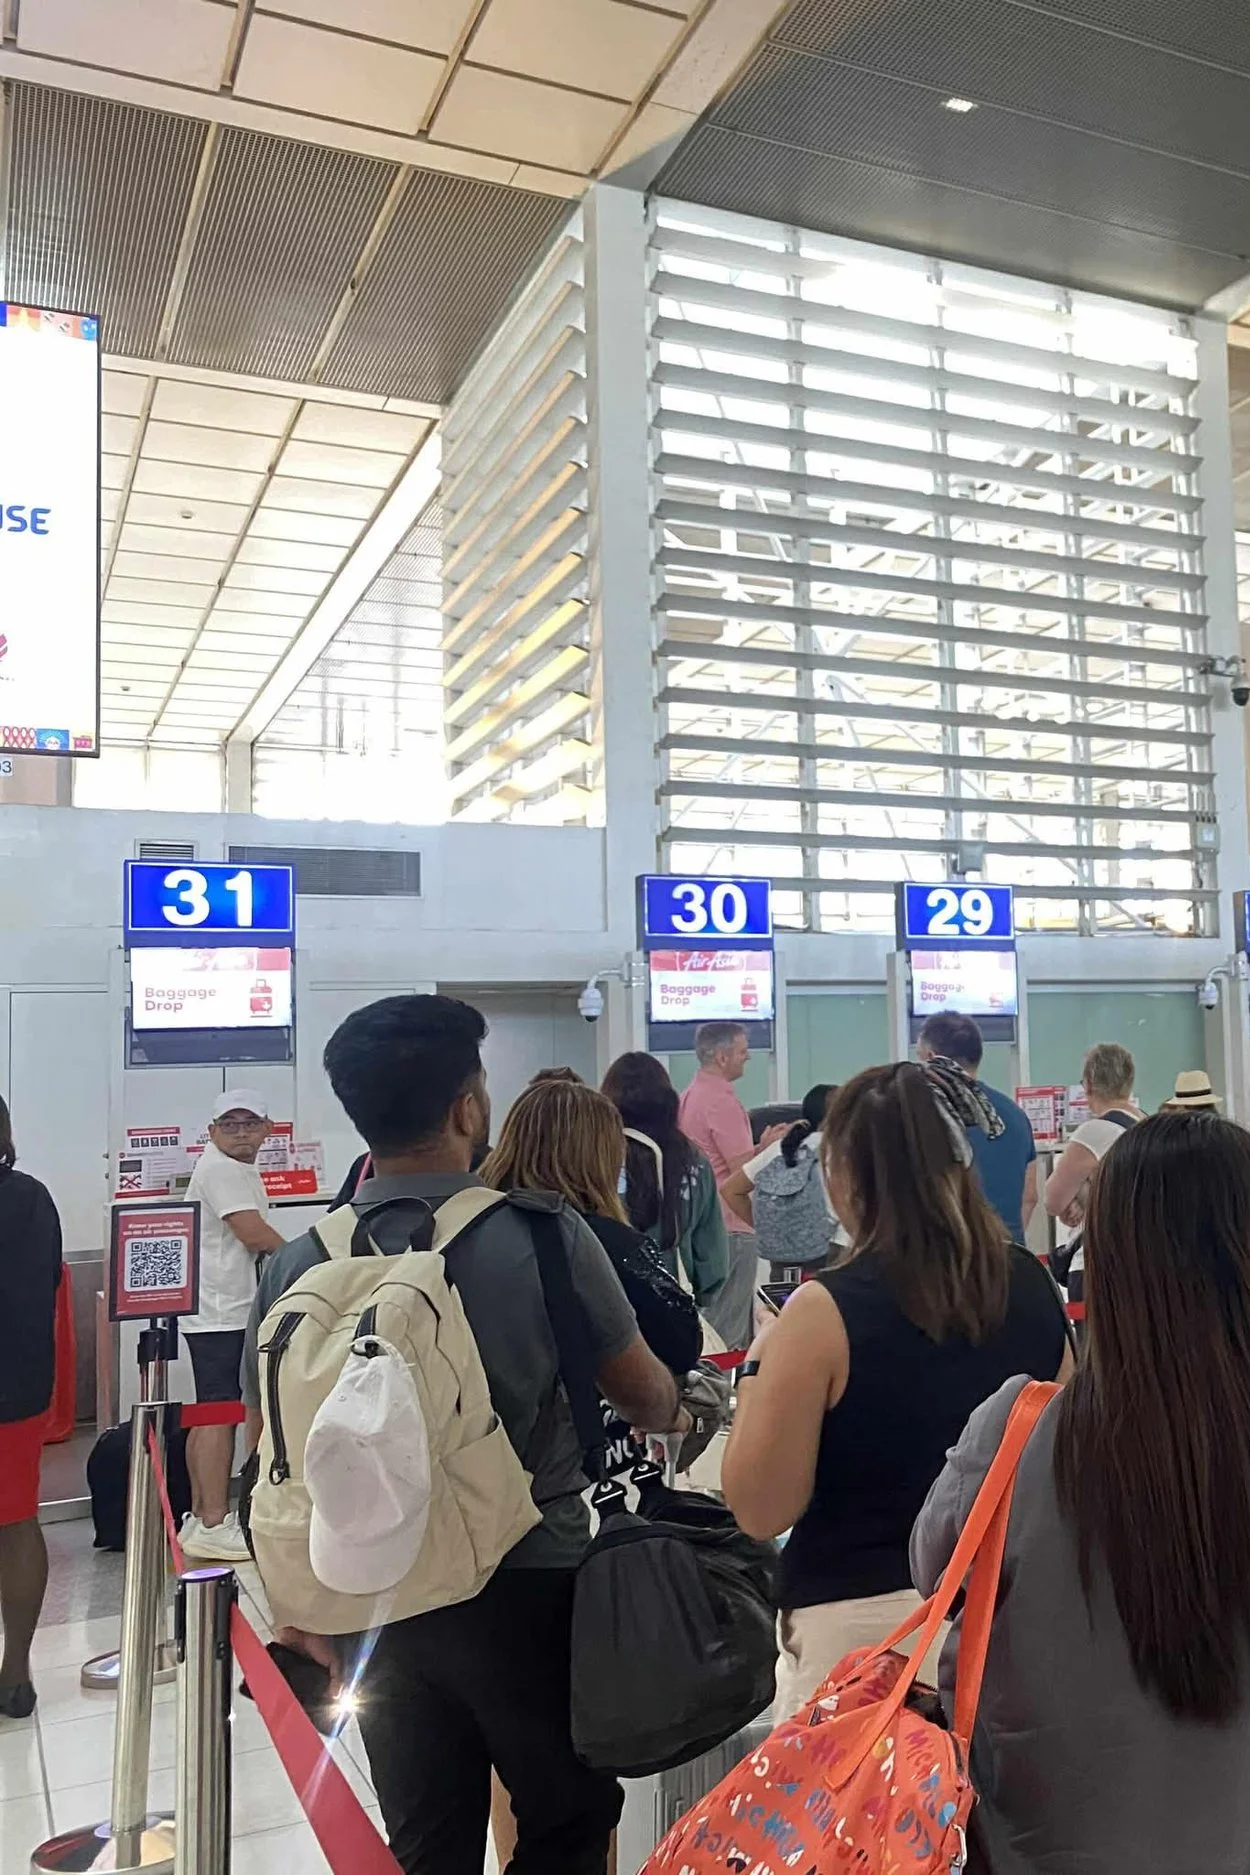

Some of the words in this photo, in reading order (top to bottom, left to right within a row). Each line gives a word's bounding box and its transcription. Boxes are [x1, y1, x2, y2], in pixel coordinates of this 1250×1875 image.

[0, 504, 51, 535] SE
[0, 760, 12, 773] 3
[162, 869, 253, 927] 31
[670, 883, 748, 933] 30
[926, 888, 994, 936] 29
[145, 987, 216, 1000] Baggage
[660, 984, 716, 996] Baggage
[660, 995, 690, 1006] Drop
[920, 992, 947, 1002] Drop
[145, 1000, 184, 1013] Drop
